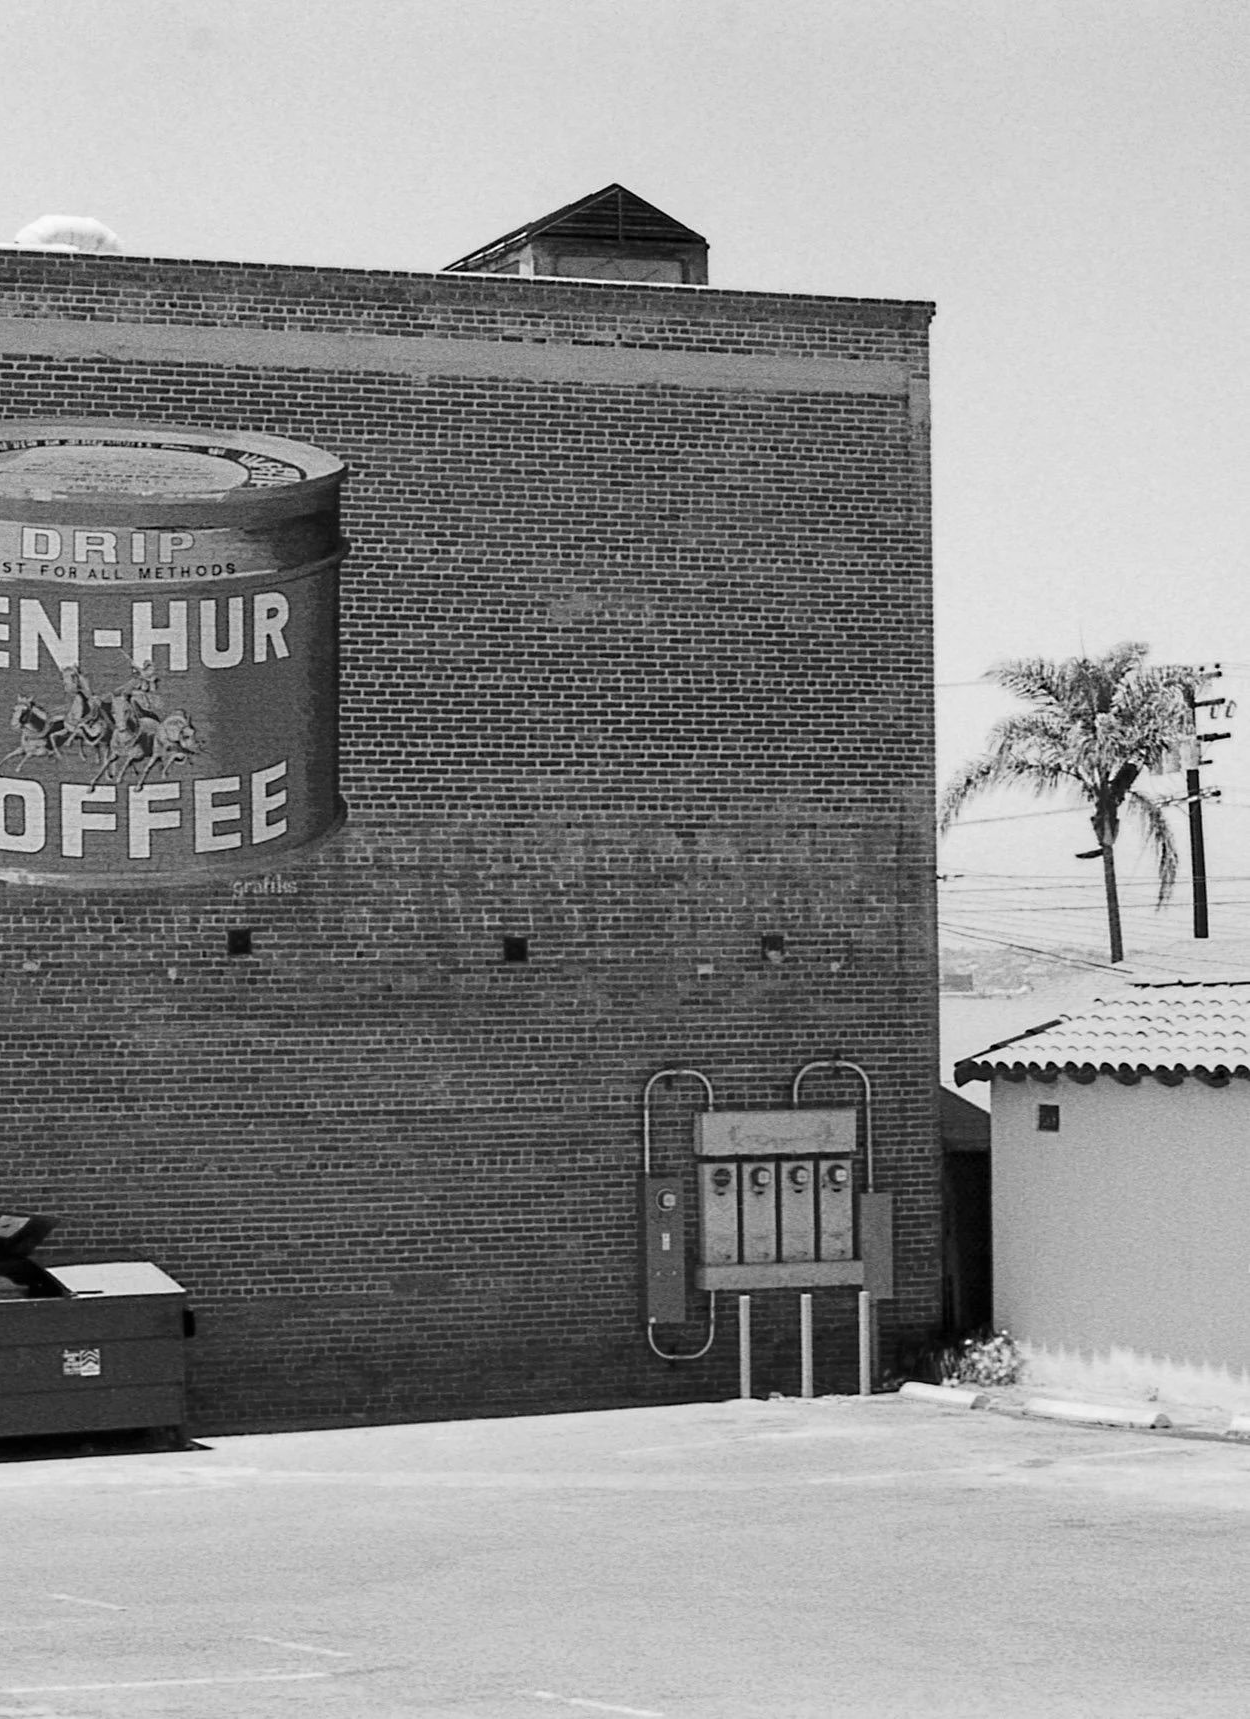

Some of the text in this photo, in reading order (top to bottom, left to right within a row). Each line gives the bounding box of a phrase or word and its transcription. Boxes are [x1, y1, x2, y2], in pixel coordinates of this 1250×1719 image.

[20, 526, 195, 564] DRIP
[40, 565, 78, 579] FOR
[88, 567, 123, 580] ALL
[138, 562, 237, 580] METHODS
